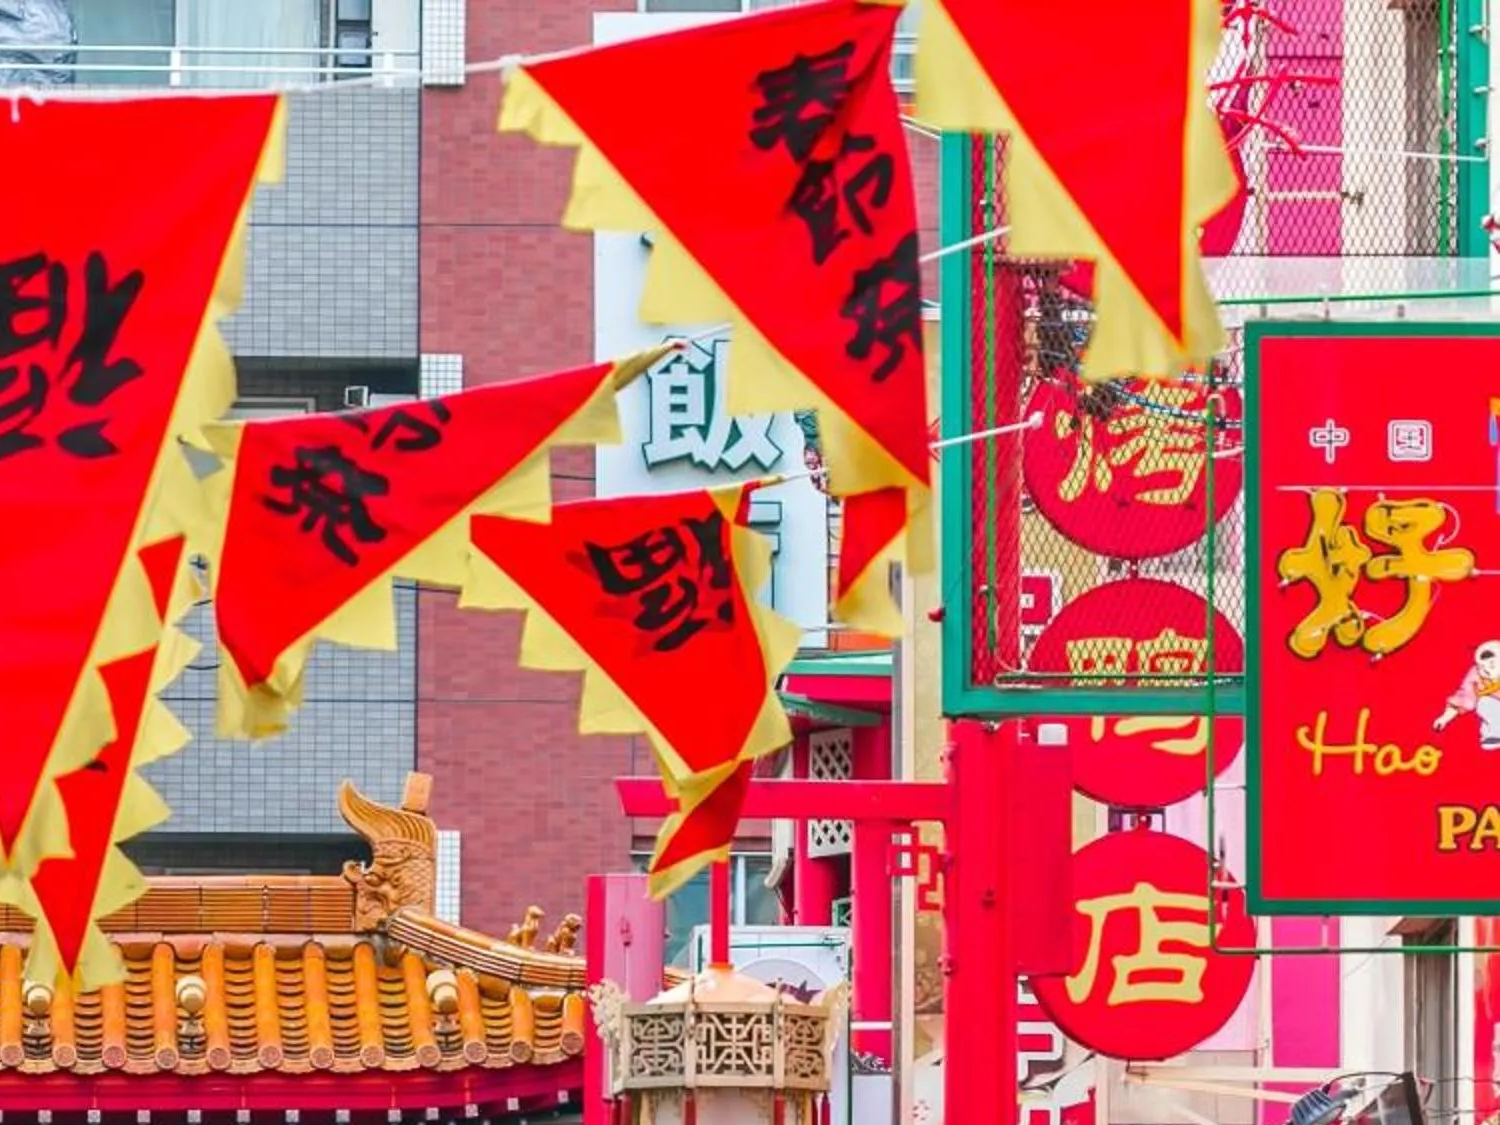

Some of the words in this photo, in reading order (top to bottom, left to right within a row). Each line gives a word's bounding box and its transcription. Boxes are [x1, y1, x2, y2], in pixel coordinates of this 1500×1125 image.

[1279, 486, 1476, 659] 好
[1297, 707, 1442, 775] Hao
[1436, 803, 1500, 851] PA
